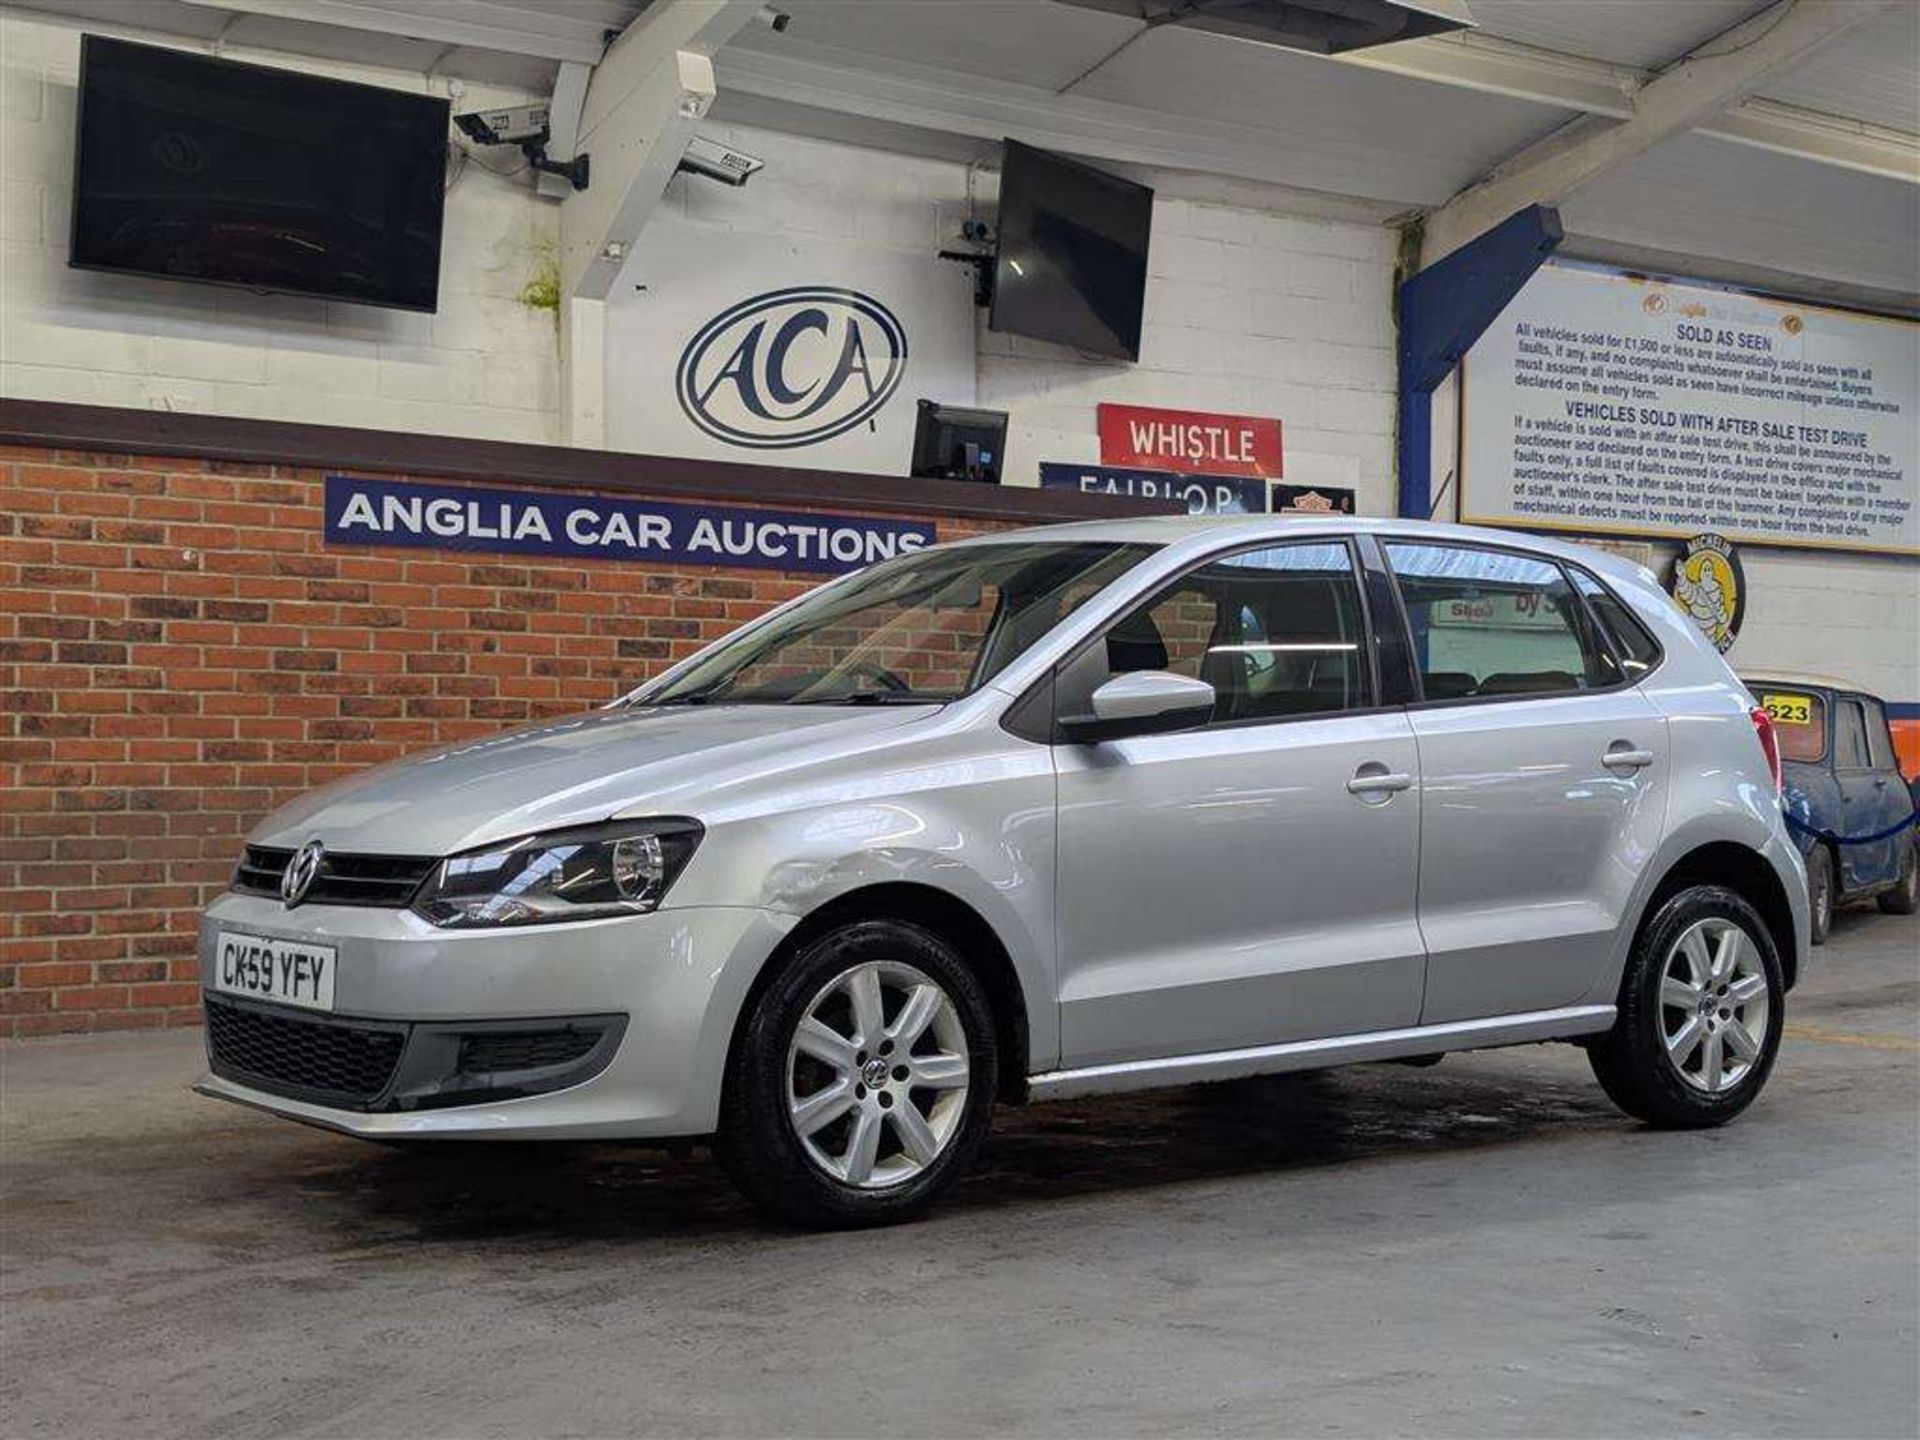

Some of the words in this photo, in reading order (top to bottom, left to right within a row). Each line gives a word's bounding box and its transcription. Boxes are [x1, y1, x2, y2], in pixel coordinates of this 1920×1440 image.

[1516, 323, 1529, 336] All
[1534, 327, 1577, 342] vehicles
[1581, 333, 1603, 345] sold
[1607, 335, 1621, 347] for
[1660, 344, 1670, 354] or
[1674, 343, 1694, 357] less
[1697, 349, 1712, 359] are
[1715, 351, 1776, 370] automatically
[1780, 359, 1799, 370] sold
[1803, 363, 1814, 372] as
[1816, 365, 1838, 375] seen
[1841, 366, 1858, 378] with
[1861, 368, 1871, 379] all
[1677, 324, 1712, 343] SOLD
[1716, 331, 1734, 346] AS
[1738, 333, 1772, 350] SEEN
[699, 308, 876, 428] ACA
[1515, 359, 1542, 371] must
[1545, 363, 1586, 376] assume
[1590, 366, 1602, 378] all
[1607, 369, 1648, 383] vehicles
[1652, 374, 1672, 386] sold
[1676, 378, 1687, 388] as
[1690, 380, 1712, 391] seen
[1715, 381, 1738, 394] have
[1741, 384, 1783, 399] incorrect
[1515, 373, 1561, 389] declared
[1565, 381, 1578, 391] on
[1582, 381, 1598, 393] the
[1602, 385, 1629, 399] entry
[1555, 344, 1562, 356] if
[1590, 350, 1609, 362] and
[1613, 354, 1626, 364] no
[1629, 356, 1683, 371] complaints
[1688, 362, 1741, 378] whatsoever
[1745, 369, 1767, 381] shall
[1770, 372, 1782, 383] be
[1841, 380, 1871, 395] Buyers
[1130, 420, 1256, 463] WHISTLE
[1514, 416, 1522, 427] If
[1526, 420, 1531, 428] a
[1534, 419, 1572, 432] vehicle
[1576, 422, 1585, 434] is
[1589, 425, 1611, 436] sold
[1615, 427, 1635, 439] with
[1639, 431, 1650, 440] an
[1654, 431, 1676, 443] after
[1680, 434, 1700, 445] sale
[1702, 436, 1720, 447] test
[1753, 440, 1770, 452] this
[1774, 443, 1796, 455] shall
[1798, 445, 1810, 456] be
[1813, 449, 1861, 461] announced
[1864, 451, 1874, 465] by
[1877, 453, 1890, 464] the
[1565, 401, 1635, 423] VEHICLES
[1640, 409, 1675, 427] SOLD
[1680, 413, 1711, 431] WITH
[1716, 417, 1758, 436] AFTER
[1762, 422, 1794, 439] SALE
[1798, 426, 1828, 443] TEST
[1831, 430, 1866, 447] DRIVE
[1514, 435, 1571, 449] auctioneer
[1574, 439, 1593, 451] and
[1597, 440, 1642, 455] declared
[1646, 448, 1658, 457] on
[1661, 447, 1676, 459] the
[1679, 450, 1704, 464] entry
[1735, 454, 1741, 465] A
[1744, 455, 1762, 467] test
[1766, 457, 1788, 469] drive
[1791, 462, 1822, 472] covers
[1825, 464, 1850, 477] major
[1853, 467, 1902, 480] mechanical
[1514, 449, 1544, 463] faults
[1576, 458, 1582, 466] a
[1585, 456, 1601, 468] full
[1605, 457, 1620, 470] list
[1624, 460, 1634, 471] of
[1637, 460, 1664, 473] faults
[1668, 466, 1706, 477] covered
[1710, 467, 1718, 478] is
[1721, 468, 1767, 484] displayed
[1770, 472, 1778, 483] in
[1781, 474, 1795, 485] the
[1799, 475, 1824, 487] office
[1827, 479, 1843, 489] and
[1846, 480, 1864, 491] with
[1867, 481, 1880, 492] the
[1513, 483, 1525, 494] of
[1558, 486, 1590, 499] within
[1593, 491, 1612, 501] one
[1616, 490, 1639, 503] hour
[1643, 492, 1667, 505] from
[1668, 495, 1683, 506] the
[1687, 496, 1701, 508] fall
[1704, 498, 1713, 508] of
[1716, 498, 1731, 510] the
[1778, 503, 1795, 518] Any
[1798, 507, 1847, 520] complaints
[1850, 509, 1858, 520] of
[1861, 512, 1876, 524] any
[1879, 512, 1903, 525] major
[1615, 474, 1634, 487] The
[1637, 477, 1660, 489] after
[1663, 479, 1682, 491] sale
[1686, 481, 1704, 493] test
[1707, 482, 1731, 495] drive
[1734, 487, 1757, 497] must
[1760, 487, 1771, 498] be
[1806, 492, 1844, 505] together
[1846, 495, 1865, 506] with
[1868, 499, 1872, 507] a
[1875, 499, 1909, 510] member
[337, 492, 552, 542] ANGLIA
[565, 509, 673, 549] CAR
[687, 519, 926, 562] AUCTIONS
[1513, 500, 1575, 514] mechanical
[1578, 503, 1616, 517] defects
[1620, 509, 1646, 519] must
[1649, 509, 1661, 520] be
[1664, 513, 1706, 525] reported
[1710, 514, 1737, 526] within
[1740, 519, 1758, 528] one
[1760, 517, 1782, 529] hour
[1784, 519, 1806, 531] from
[1809, 521, 1824, 533] the
[1826, 523, 1844, 534] test
[223, 943, 273, 993] CK59
[280, 951, 325, 1001] YFY
